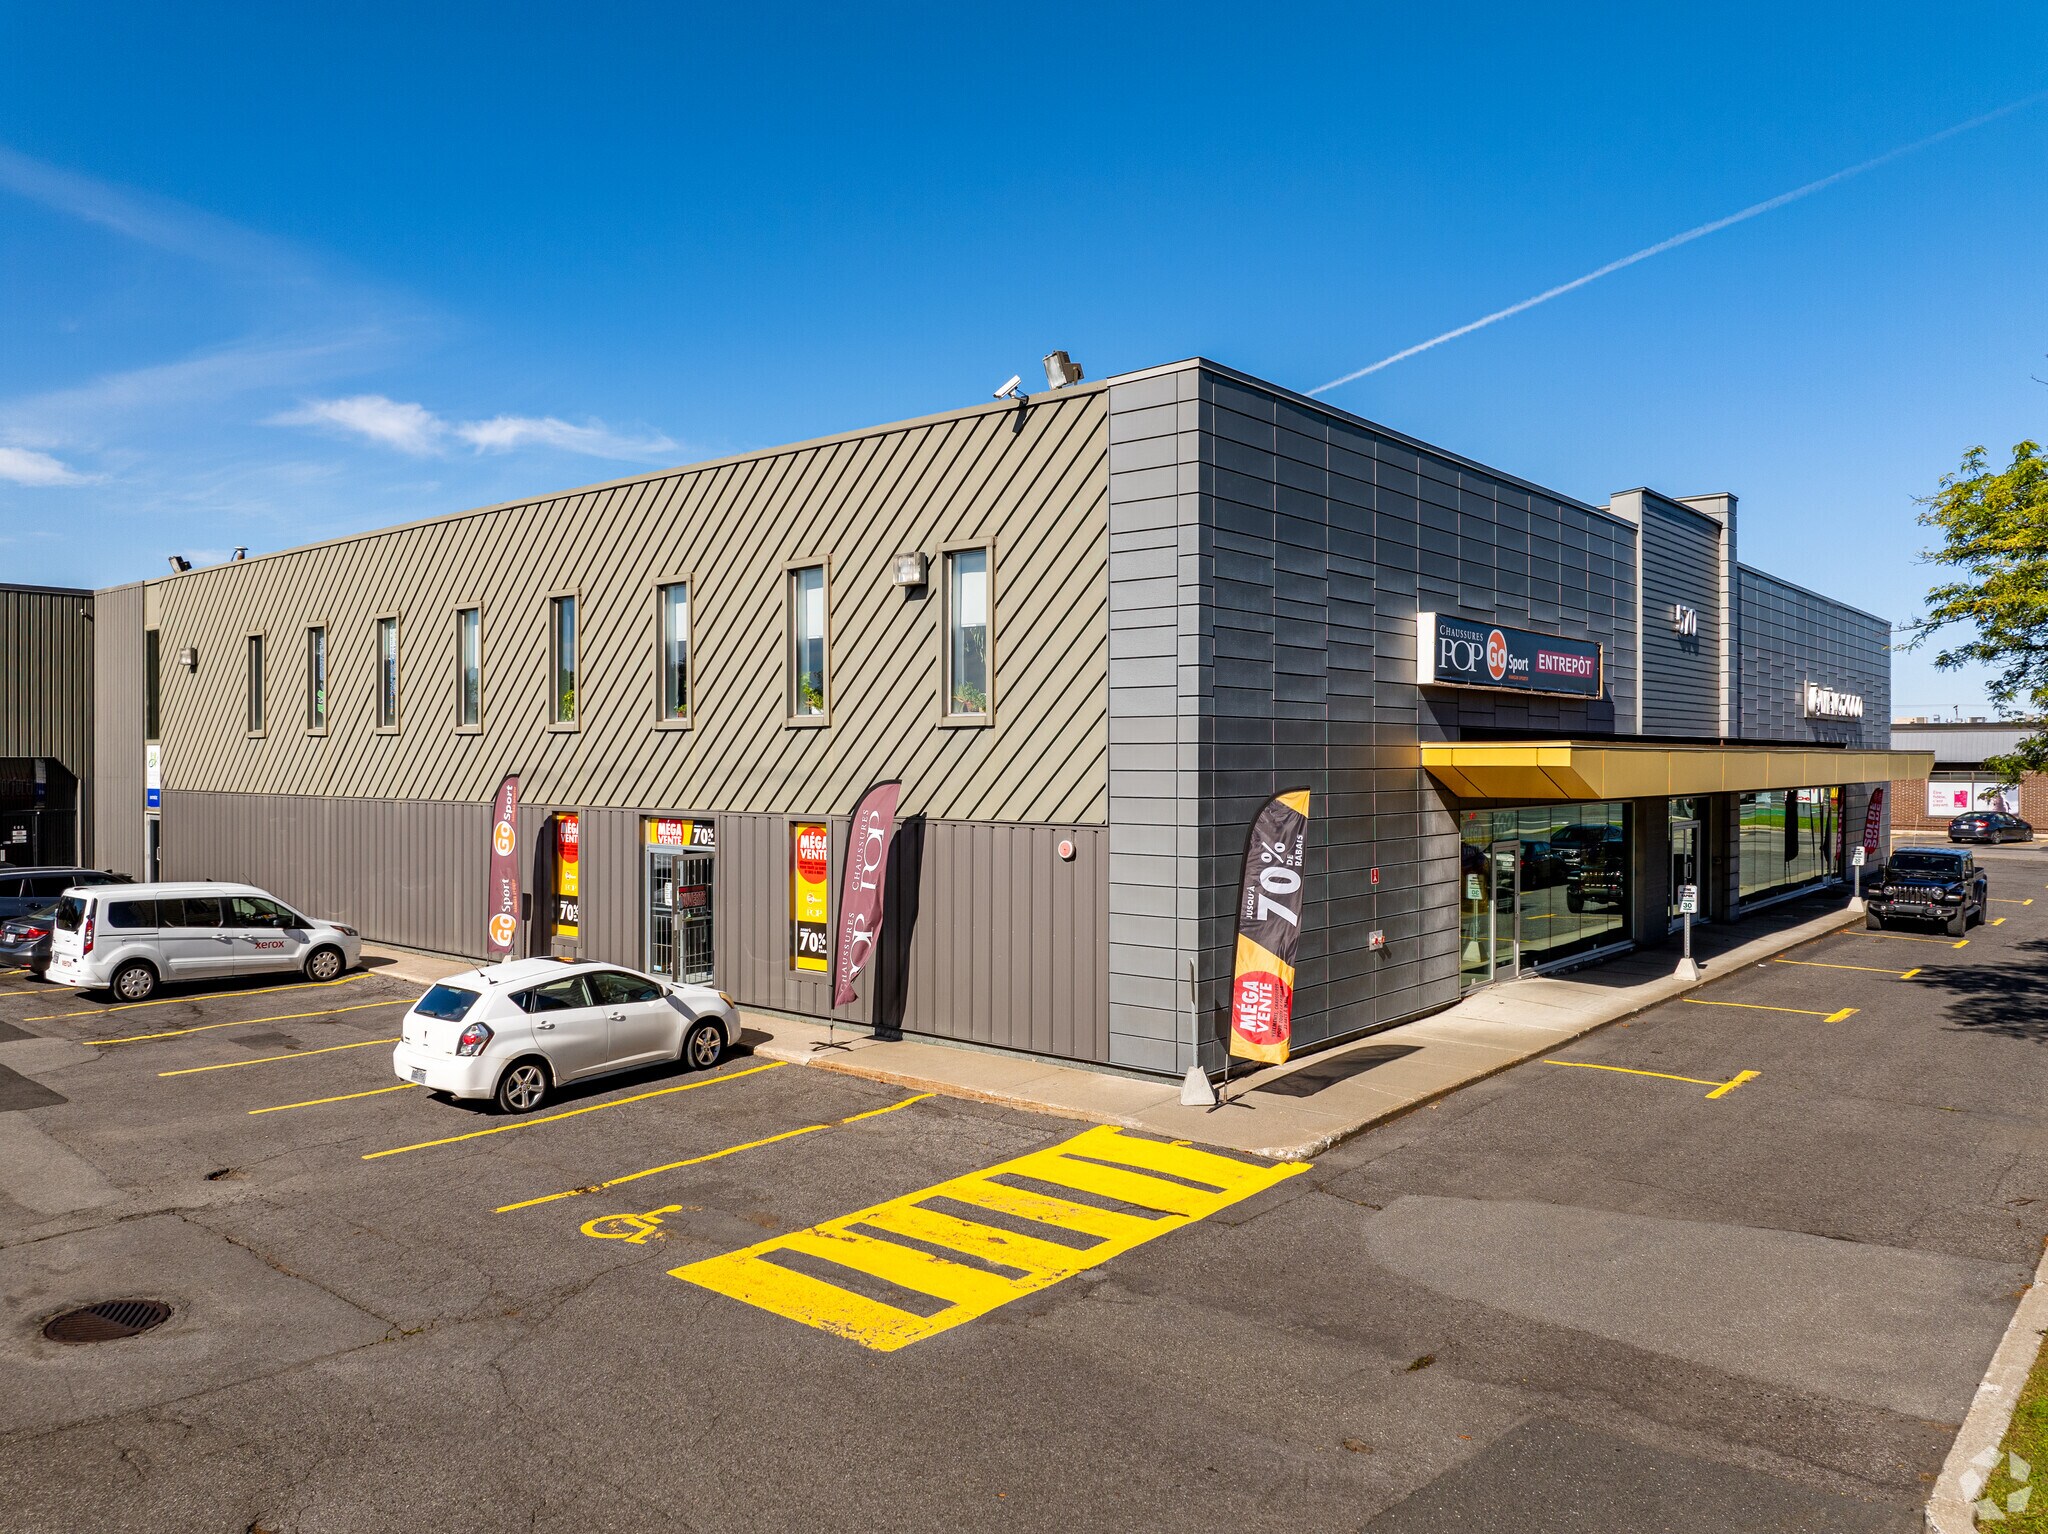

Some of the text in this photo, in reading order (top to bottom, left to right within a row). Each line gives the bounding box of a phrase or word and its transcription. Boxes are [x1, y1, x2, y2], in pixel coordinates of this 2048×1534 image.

[1439, 625, 1484, 642] CHAUSSURES
[1438, 637, 1484, 672] POP
[1508, 654, 1529, 674] Sport
[1538, 654, 1592, 675] ENTREPÔT
[504, 784, 513, 821] Sport
[658, 820, 682, 836] MÉGA
[658, 836, 682, 845] VENTE
[693, 828, 714, 844] 70%
[1864, 802, 1877, 848] SOLDE
[852, 808, 869, 891] CHAUSSURES
[860, 810, 884, 892] POP
[1286, 854, 1294, 866] DE
[1295, 834, 1304, 866] RABAIS
[502, 878, 514, 912] Sport
[1256, 841, 1301, 928] 70%
[1246, 885, 1256, 920] JUSQU'À
[254, 940, 284, 950] xerox
[800, 932, 826, 952] 70%
[1236, 980, 1260, 1032] MÉGA
[1256, 982, 1273, 1033] VENTE
